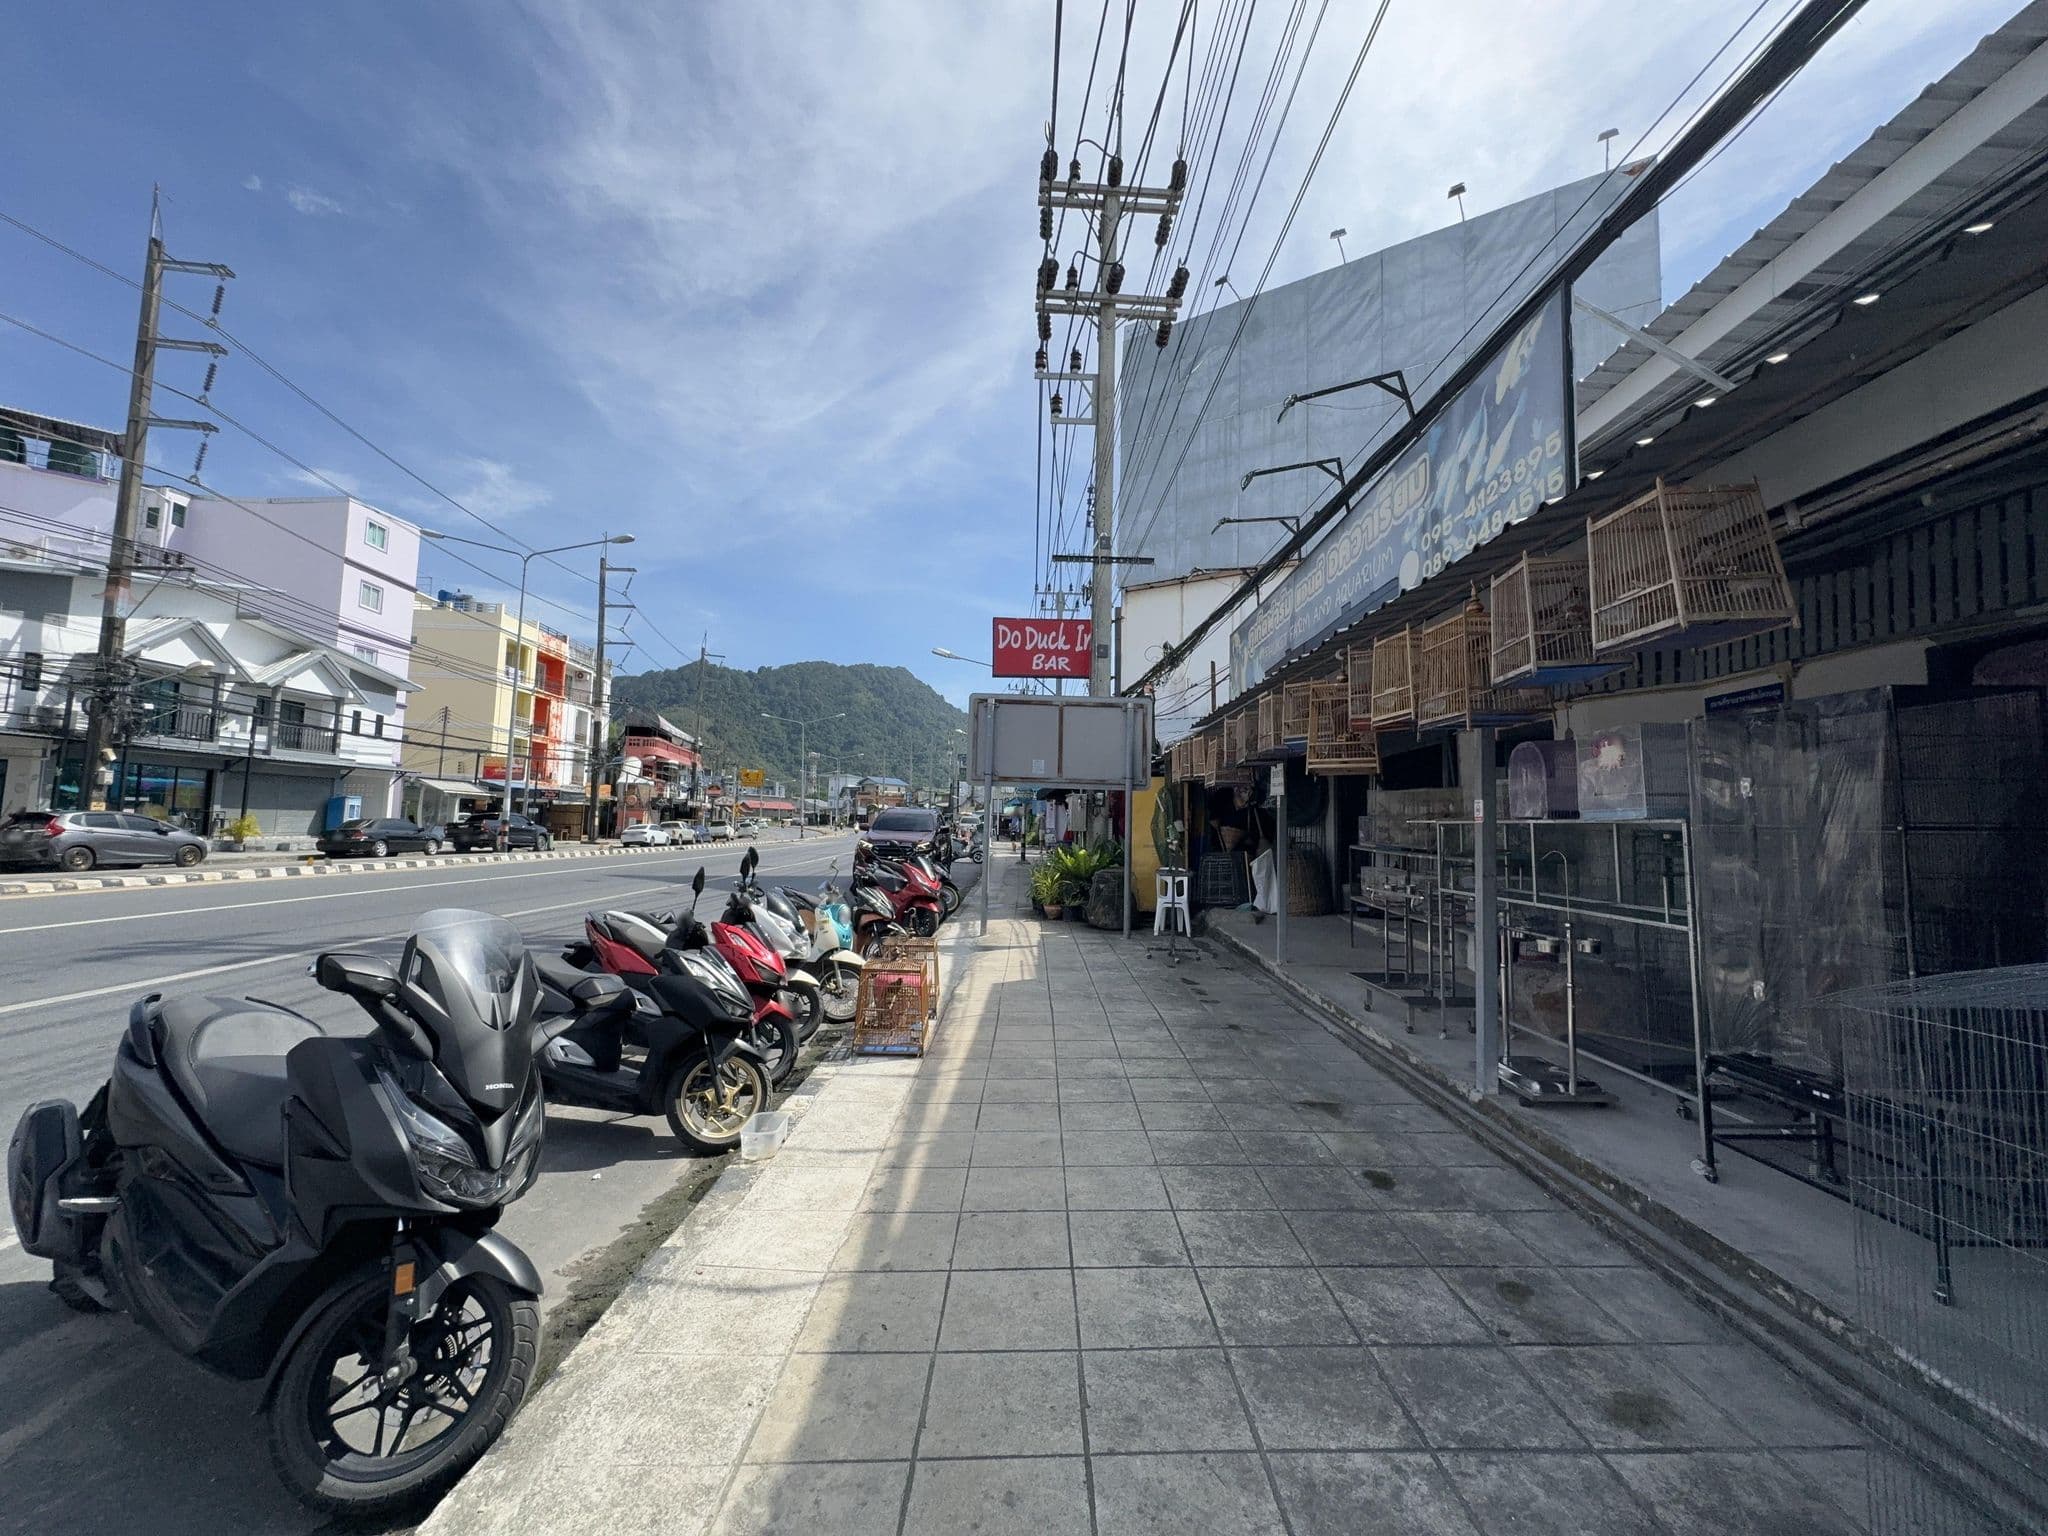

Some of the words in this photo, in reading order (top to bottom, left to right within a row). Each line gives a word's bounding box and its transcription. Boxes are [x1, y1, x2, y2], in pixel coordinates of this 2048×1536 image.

[1421, 430, 1562, 551] 095-4123895
[1423, 466, 1564, 577] 089-6484515
[1313, 596, 1332, 620] AND
[1335, 546, 1393, 607] AQUARIUM
[998, 624, 1021, 649] Do
[1025, 622, 1070, 650] Duck
[1032, 653, 1071, 671] BAR
[485, 1082, 514, 1090] HONDA
